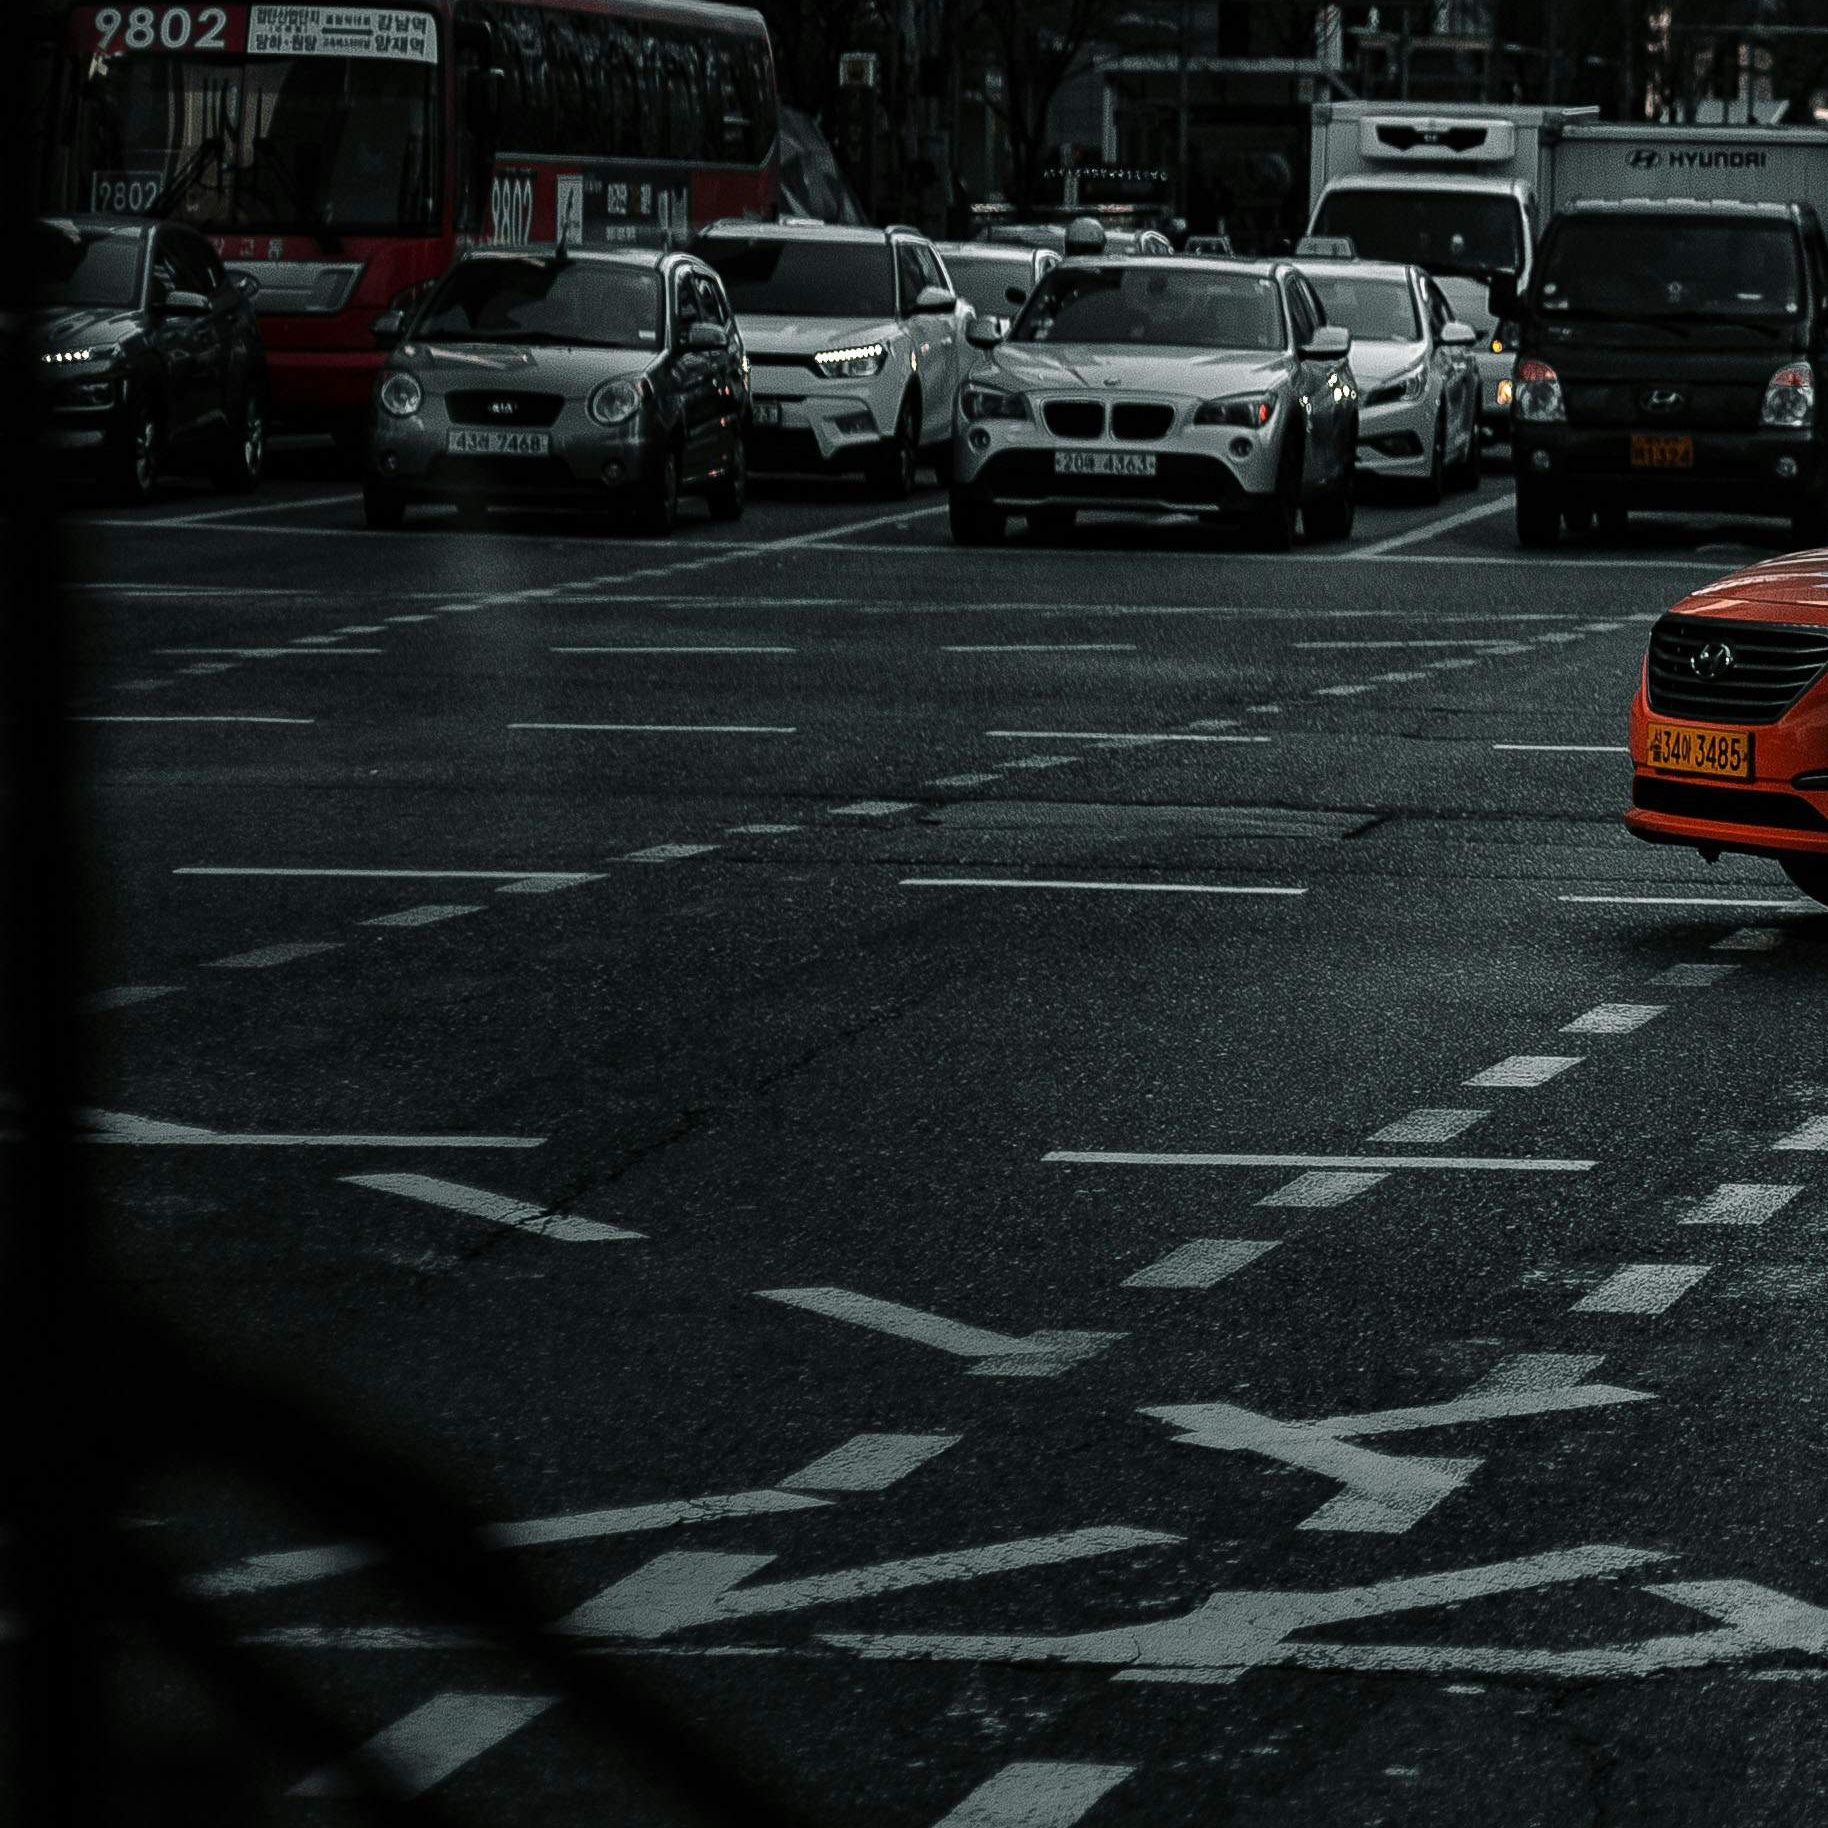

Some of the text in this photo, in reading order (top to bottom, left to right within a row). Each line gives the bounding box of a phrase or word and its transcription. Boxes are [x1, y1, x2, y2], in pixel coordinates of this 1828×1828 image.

[94, 5, 228, 50] 9802
[377, 13, 427, 34] 강남역
[375, 34, 426, 55] 양재역
[1669, 151, 1766, 168] HYUNDAI
[99, 181, 158, 213] 9802
[1695, 734, 1741, 771] 3485
